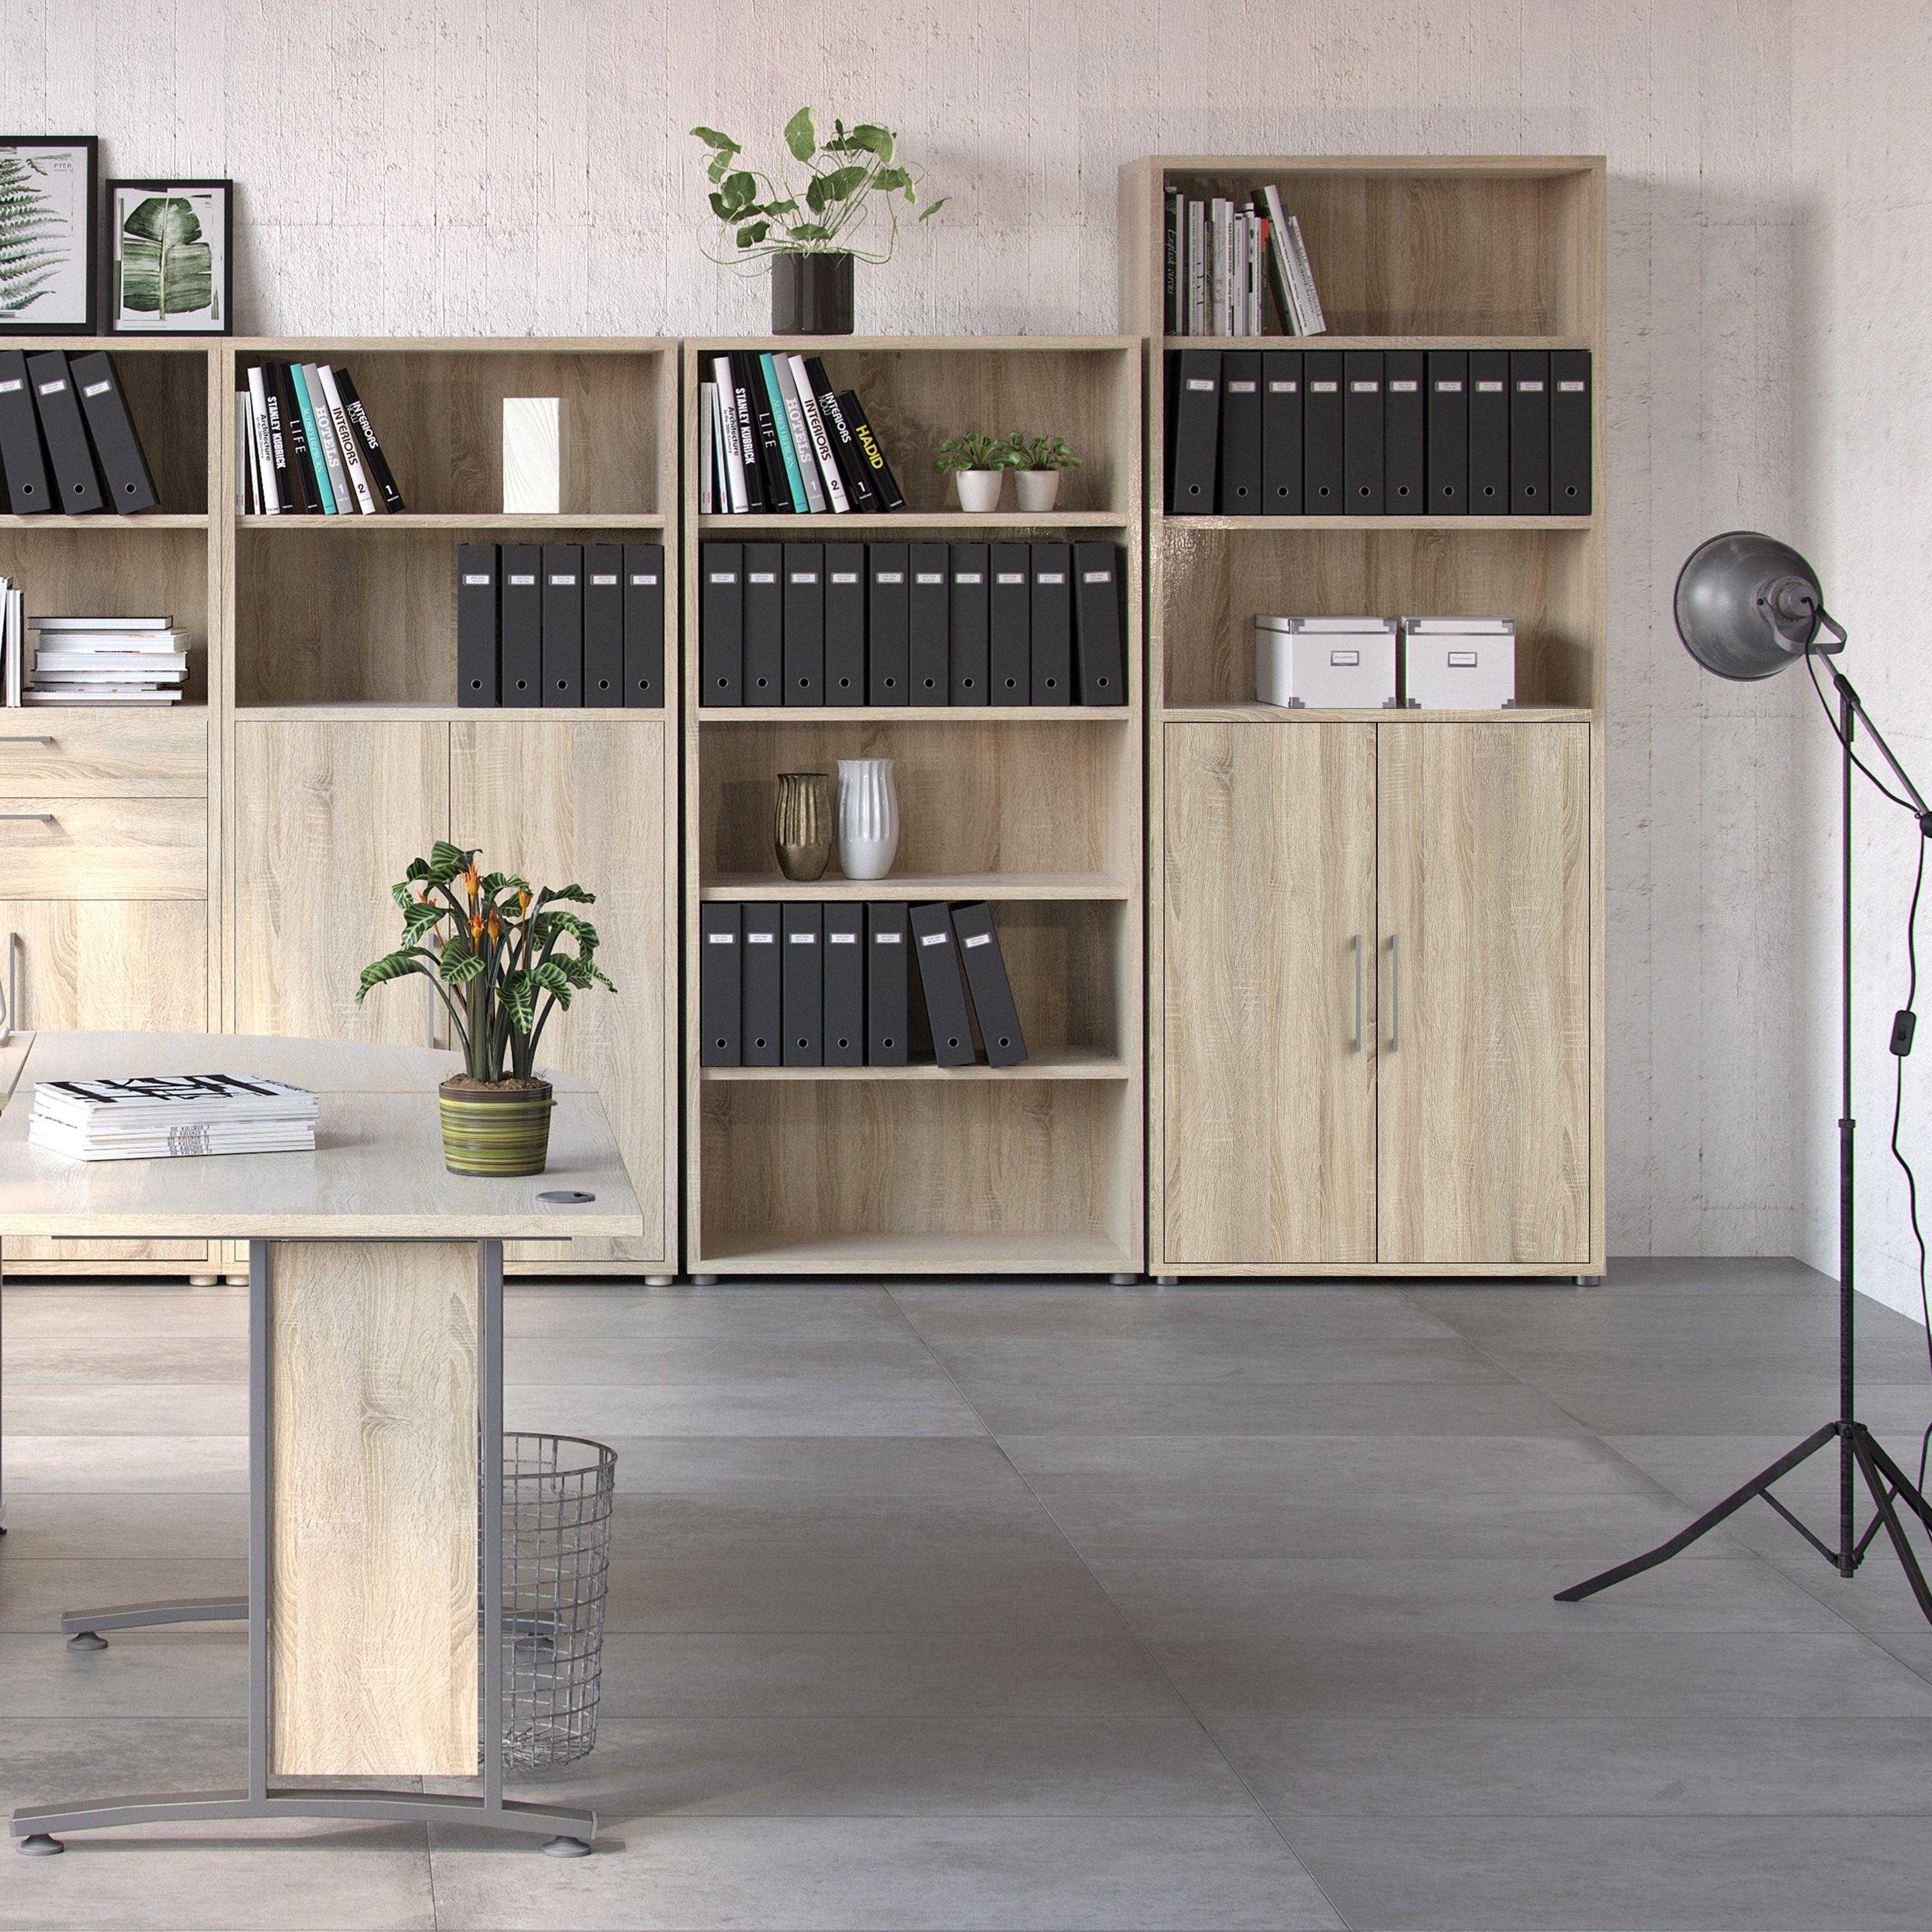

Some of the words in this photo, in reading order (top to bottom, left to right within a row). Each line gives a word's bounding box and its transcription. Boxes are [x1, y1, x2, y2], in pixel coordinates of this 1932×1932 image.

[1166, 229, 1177, 264] English
[267, 396, 280, 430] STANLEY
[346, 404, 360, 424] NOW
[735, 387, 750, 424] STANLEY
[818, 395, 831, 416] NOW
[824, 392, 851, 444] INTERIORS
[260, 414, 270, 461] Architecture
[290, 420, 307, 453] LIFE
[315, 405, 339, 468] HOTELS
[333, 407, 359, 466] INTERIORS
[351, 401, 379, 450] INTERIORS
[728, 407, 739, 456] Architecture
[759, 413, 777, 448] LIFE
[786, 397, 811, 463] HOTELS
[804, 399, 831, 461] INTERIORS
[272, 432, 286, 469] KUBRICK
[741, 426, 755, 465] KUBRICK
[855, 424, 884, 469] HADID
[338, 484, 345, 494] 1
[358, 484, 366, 493] 2
[385, 485, 393, 495] 1
[810, 480, 817, 491] 1
[831, 480, 839, 491] 2
[858, 481, 866, 492] 1
